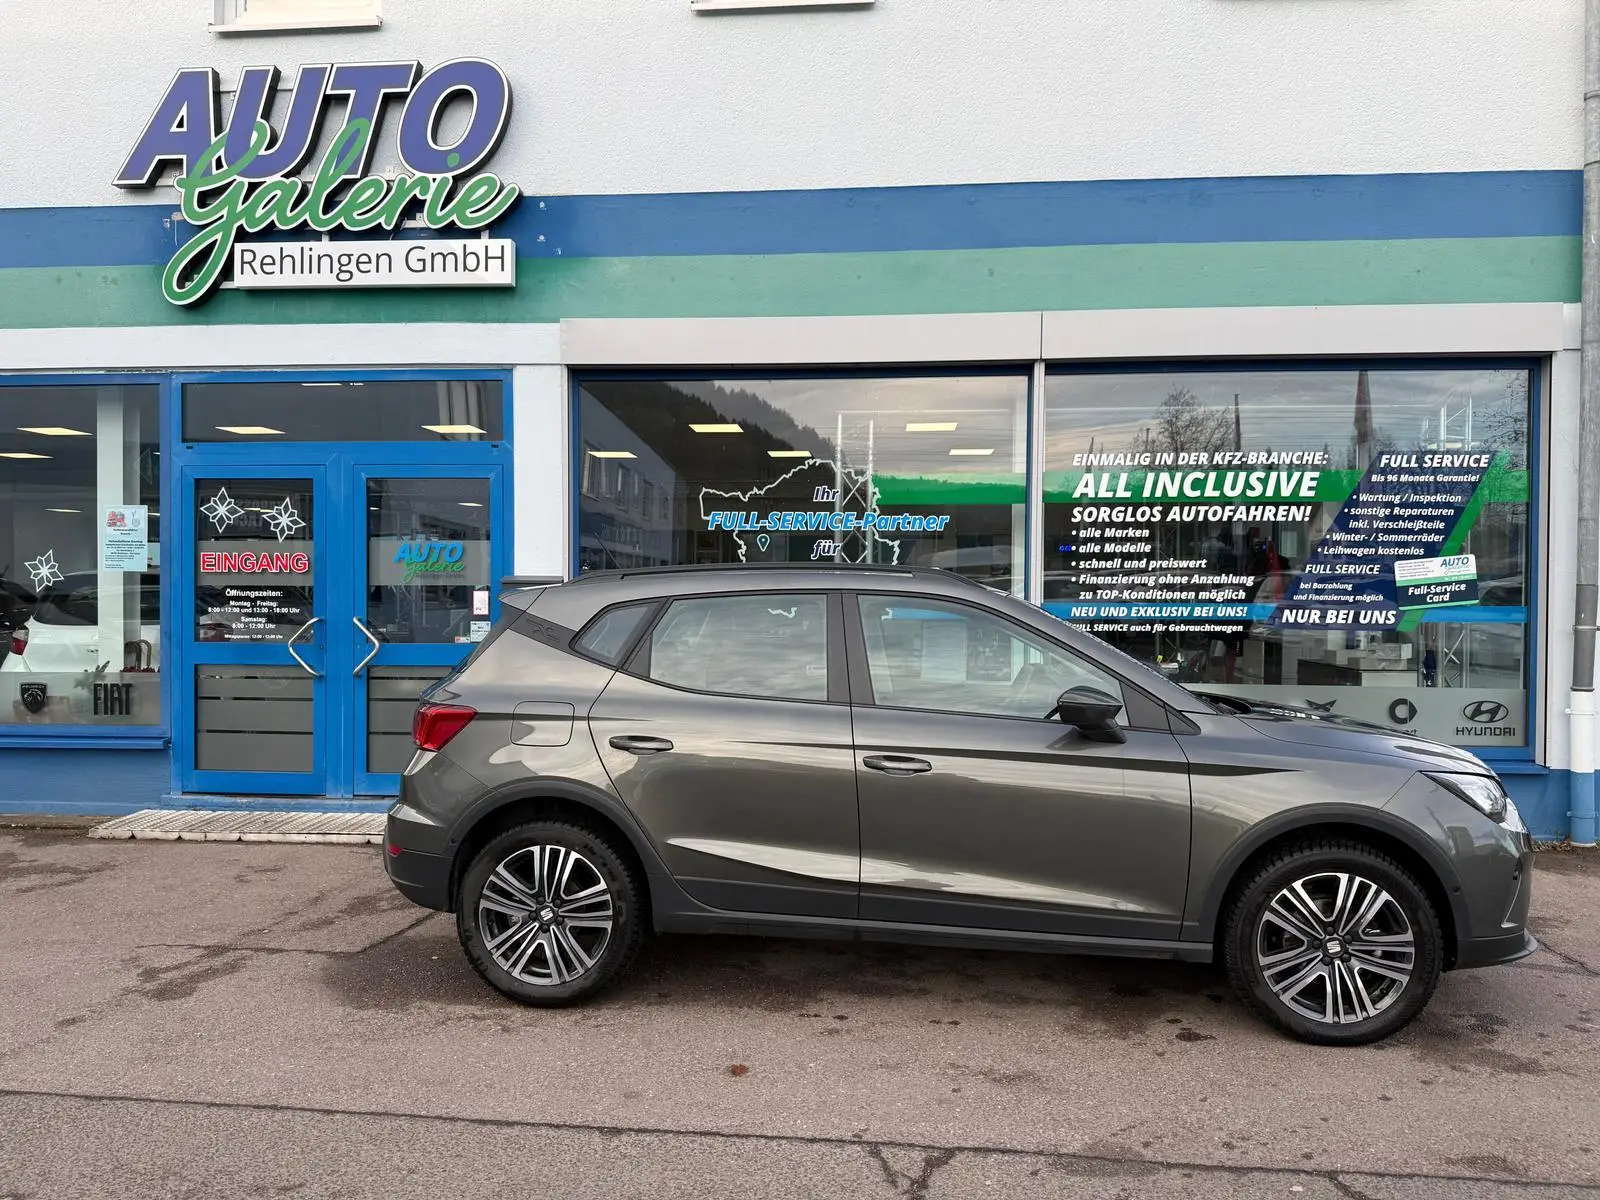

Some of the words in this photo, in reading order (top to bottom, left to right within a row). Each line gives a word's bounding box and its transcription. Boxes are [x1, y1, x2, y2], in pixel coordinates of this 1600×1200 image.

[111, 57, 510, 188] AUTO
[162, 117, 520, 306] Galerie
[240, 247, 393, 280] Rehlingen
[405, 245, 505, 274] GmbH
[1072, 453, 1150, 466] EINMALIG
[1154, 452, 1174, 465] IN
[1177, 452, 1208, 465] DER
[1213, 452, 1328, 465] KFZ-BRANCHE:
[1380, 455, 1418, 468] FULL
[1423, 455, 1490, 467] SERVICE
[1371, 474, 1385, 482] Bis
[1387, 474, 1398, 482] 96
[1400, 474, 1434, 482] Monate
[1437, 474, 1479, 482] Garantie!
[1072, 472, 1132, 498] ALL
[1142, 471, 1320, 498] INCLUSIVE
[813, 485, 840, 502] Ihr
[1359, 493, 1400, 505] Wartung
[1410, 493, 1461, 505] Inspektion
[1071, 506, 1162, 522] SORGLOS
[1166, 505, 1312, 522] AUTOFAHREN!
[1350, 507, 1391, 516] sonstige
[1394, 507, 1454, 518] Reparaturen
[708, 511, 949, 531] FULL-SERVICE-Partner
[1349, 520, 1370, 529] inkl.
[1373, 520, 1445, 529] Verschleißteile
[1079, 528, 1101, 538] alle
[1104, 528, 1150, 538] Marken
[1332, 533, 1368, 542] Winter-
[1377, 533, 1444, 542] Sommerräder
[393, 543, 464, 563] AUTO
[811, 540, 841, 559] für
[1079, 543, 1101, 553] alle
[1104, 543, 1151, 553] Modelle
[1324, 546, 1375, 556] Leihwagen
[1378, 547, 1424, 555] kostenlos
[200, 552, 309, 574] EINGANG
[1079, 558, 1121, 569] schnell
[1124, 558, 1146, 569] und
[1149, 559, 1207, 571] preiswert
[1440, 557, 1469, 567] AUTO
[1305, 565, 1333, 574] FULL
[1335, 564, 1380, 574] SERVICE
[1079, 574, 1156, 586] Finanzierung
[1159, 574, 1187, 585] ohne
[1191, 574, 1254, 586] Anzahlung
[1313, 583, 1352, 591] Barzahlung
[1408, 583, 1466, 595] Full-Service
[225, 589, 283, 598] Öffnungszeiten:
[1079, 591, 1093, 599] zu
[1096, 590, 1195, 600] TOP-Konditionen
[1198, 589, 1245, 602] möglich
[1308, 594, 1354, 603] Finanzierung
[1355, 594, 1383, 603] möglich
[1426, 593, 1450, 602] Card
[1071, 606, 1096, 617] NEU
[1100, 606, 1128, 617] UND
[1130, 606, 1190, 617] EXKLUSIV
[1193, 606, 1214, 617] BEI
[1216, 606, 1248, 617] UNS!
[1281, 609, 1320, 624] NUR
[1325, 610, 1354, 624] BEI
[1359, 611, 1397, 624] UNS
[1093, 624, 1128, 632] SERVICE
[1130, 624, 1151, 632] auch
[1152, 624, 1166, 633] für
[1169, 624, 1243, 633] Gebrauchtwagen
[94, 683, 132, 715] FIAT
[1456, 727, 1516, 736] HYUNDAI
